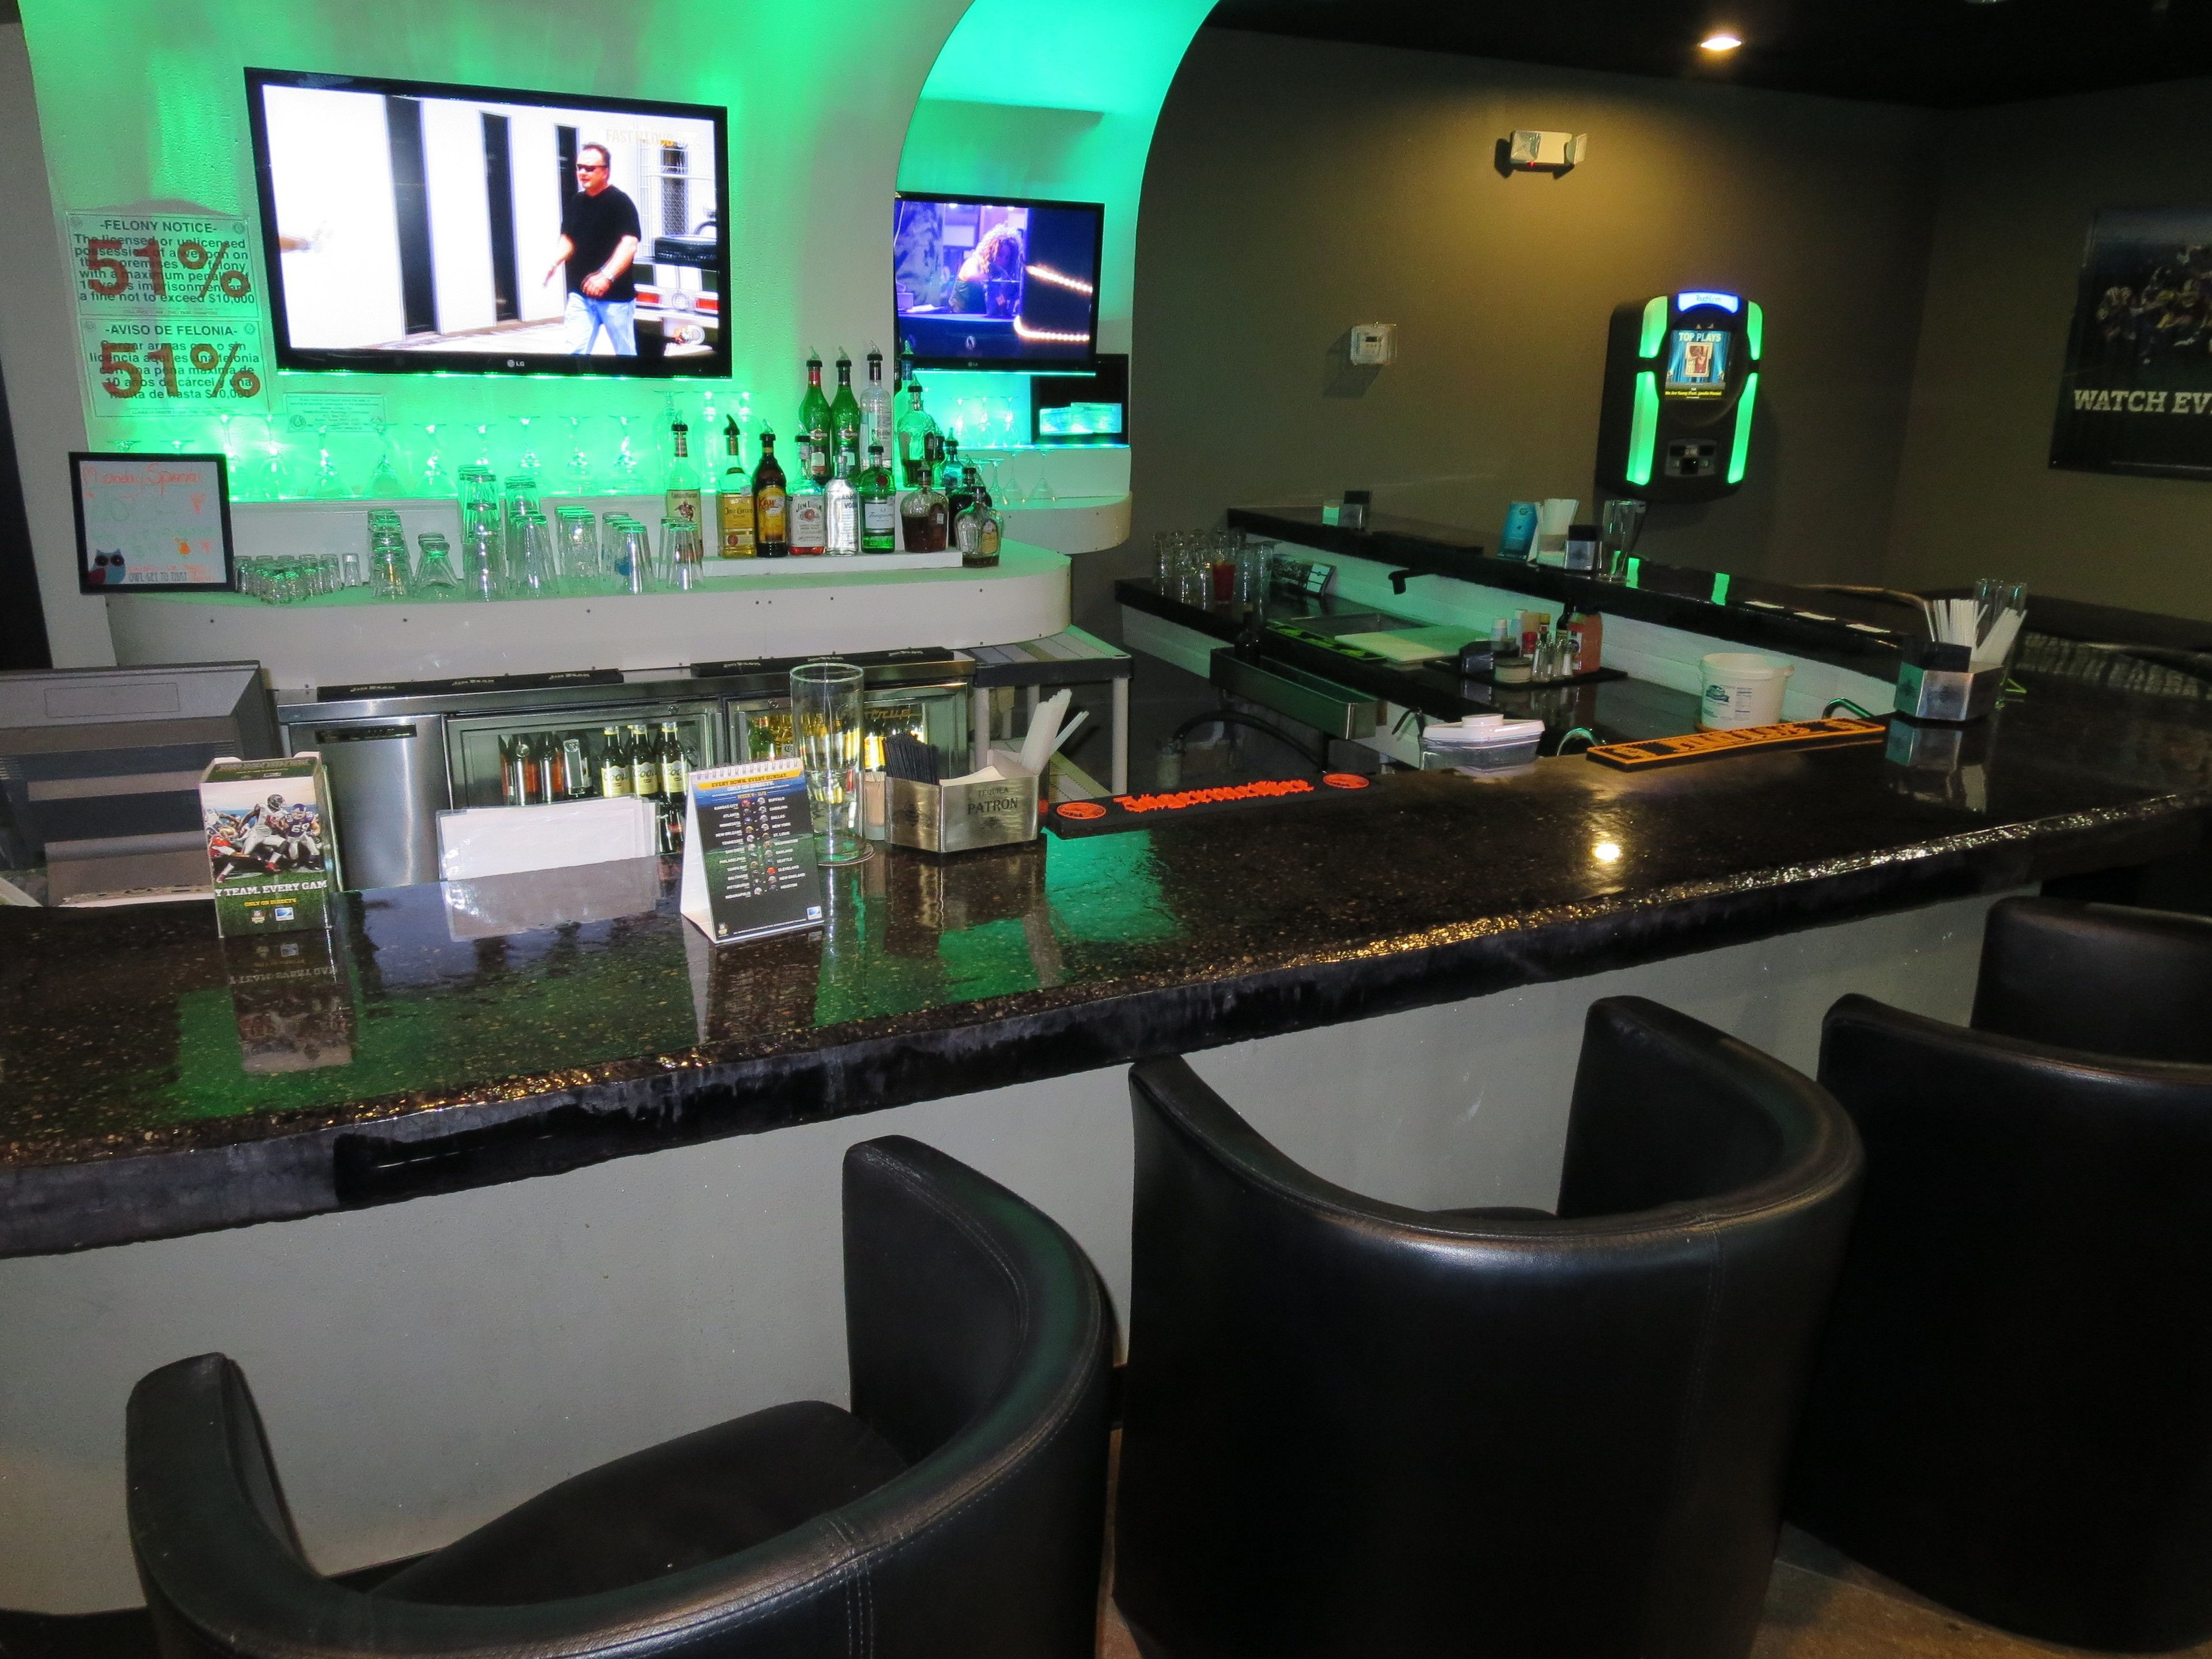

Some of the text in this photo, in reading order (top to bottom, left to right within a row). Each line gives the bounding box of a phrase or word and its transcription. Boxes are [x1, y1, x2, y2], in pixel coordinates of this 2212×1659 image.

[100, 220, 217, 233] -FELONY NOTICE-
[160, 238, 172, 246] or
[75, 246, 151, 257] posessi
[169, 249, 176, 257] a
[181, 249, 229, 261] epon
[233, 251, 248, 260] on
[88, 238, 252, 298] 51%
[120, 259, 178, 270] premes
[207, 260, 246, 273] flony
[79, 269, 106, 278] with
[122, 270, 184, 281] axium
[188, 271, 233, 283] penal
[79, 281, 92, 290] 1
[102, 281, 134, 291] yes
[138, 281, 226, 293] imisonmen
[79, 291, 255, 305] a fine not to exceed $10,000
[105, 324, 238, 336] -AVISO DE FELONIA-
[1678, 332, 1722, 342] TOP PLAYS
[217, 343, 225, 351] o
[228, 341, 247, 351] sn
[89, 353, 139, 362] licncia
[174, 354, 188, 363] es
[218, 353, 260, 363] feonia
[101, 342, 261, 398] 51%
[154, 367, 185, 377] pa
[124, 378, 155, 387] aos
[177, 376, 215, 387] cárcel
[149, 389, 165, 399] de
[204, 389, 252, 399] $0,0
[2074, 389, 2212, 414] WATCH EV
[807, 500, 822, 512] BM
[975, 786, 1009, 797] TEQUILA
[967, 797, 1019, 815] PATRON
[225, 885, 261, 896] TEAM.
[262, 882, 301, 893] EVERY
